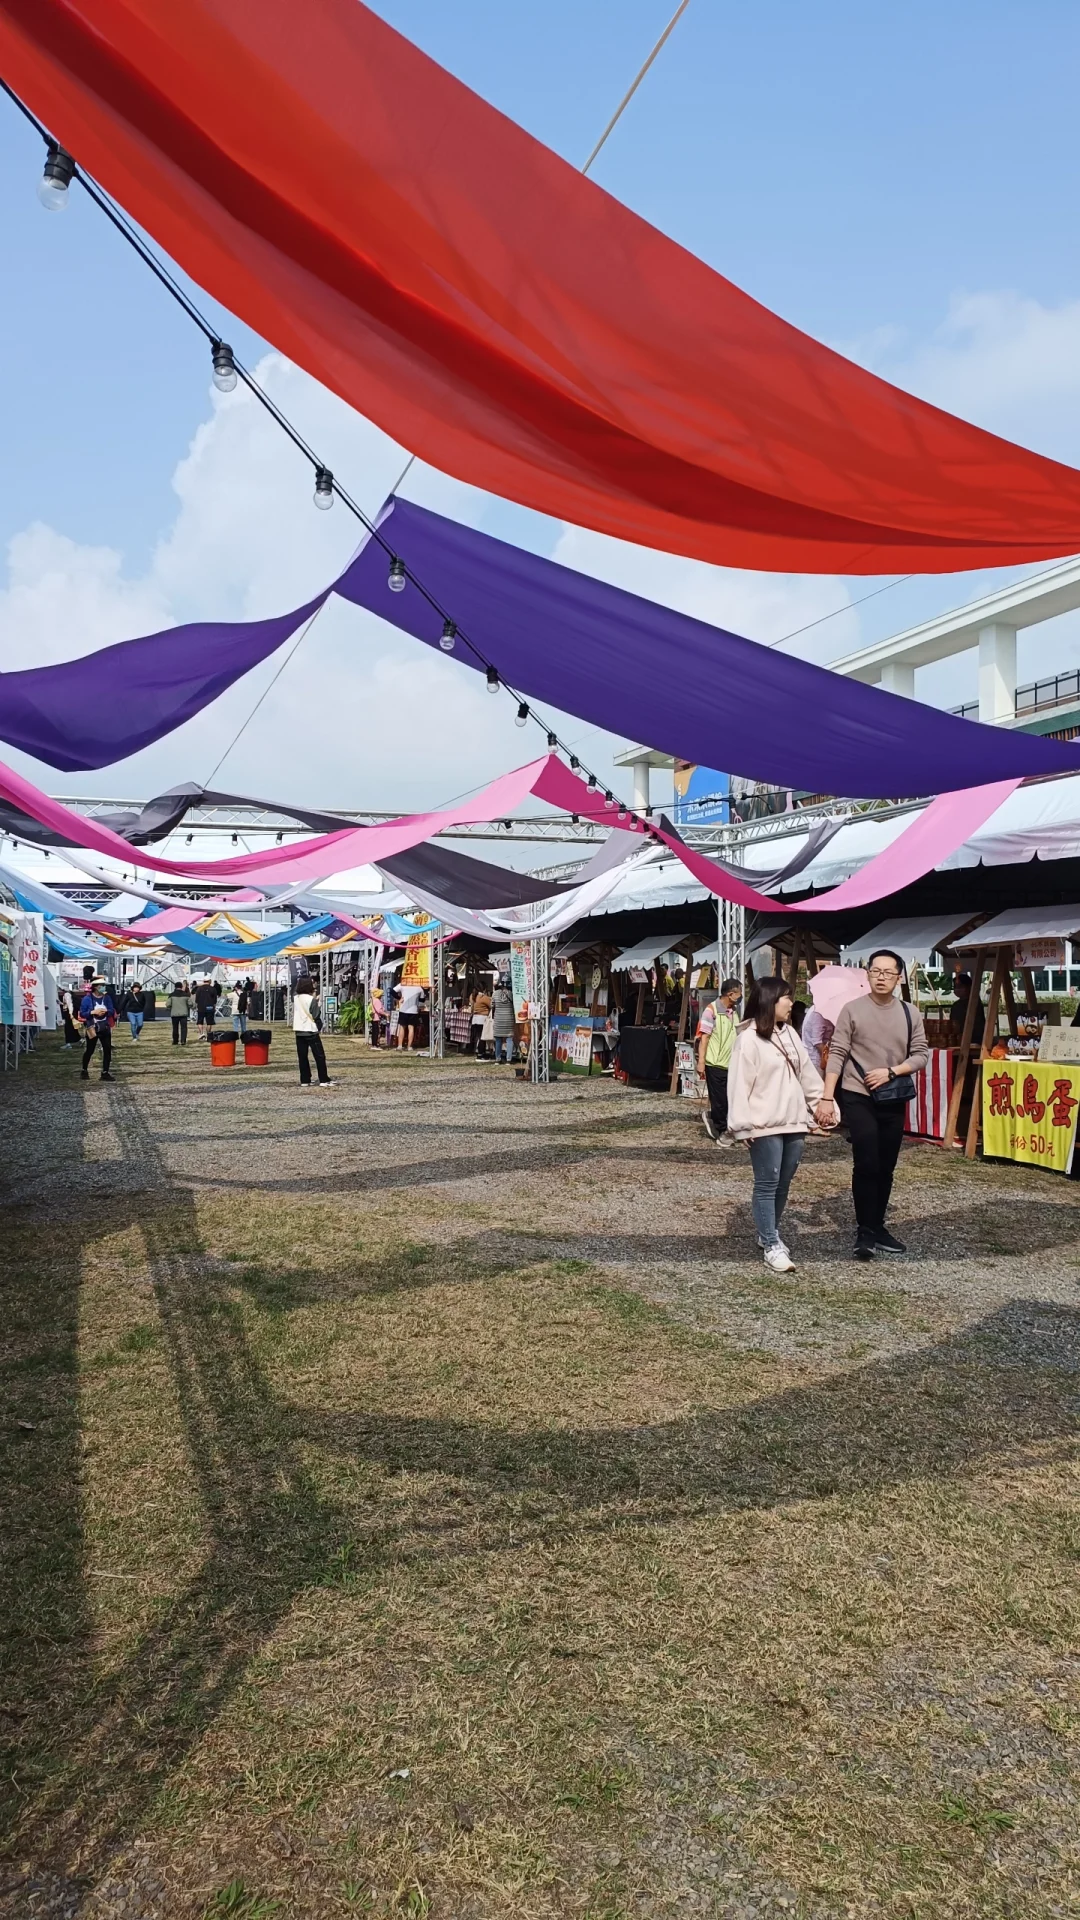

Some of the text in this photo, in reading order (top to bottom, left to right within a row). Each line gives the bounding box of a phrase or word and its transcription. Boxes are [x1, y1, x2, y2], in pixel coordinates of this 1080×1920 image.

[1031, 949, 1056, 959] 有限公司
[987, 1071, 1079, 1129] 煎鳥蛋
